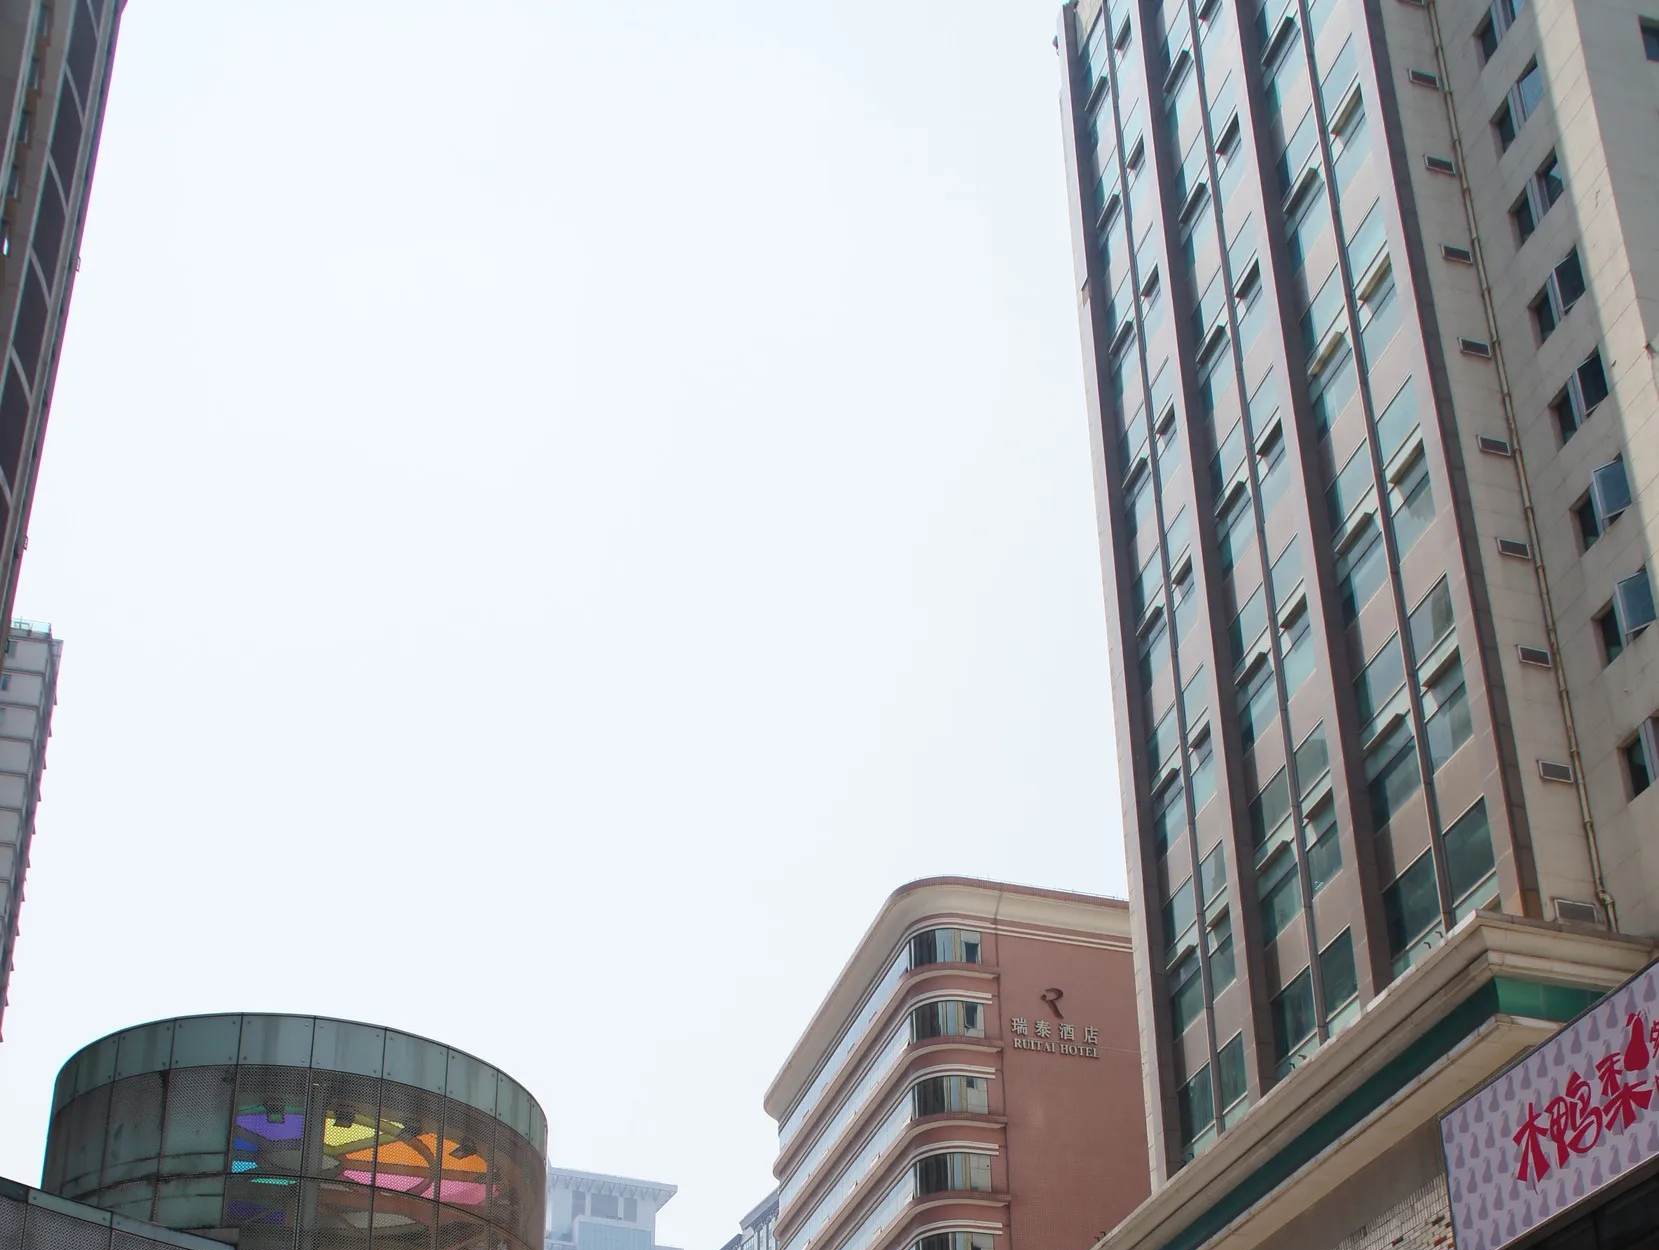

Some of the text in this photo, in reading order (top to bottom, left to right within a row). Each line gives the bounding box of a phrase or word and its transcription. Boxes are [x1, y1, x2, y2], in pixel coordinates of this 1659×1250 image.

[1011, 1017, 1099, 1045] 瑞泰酒店
[1013, 1038, 1099, 1058] RUITAI HOTEL
[1512, 1010, 1653, 1195] 木鸭梨
